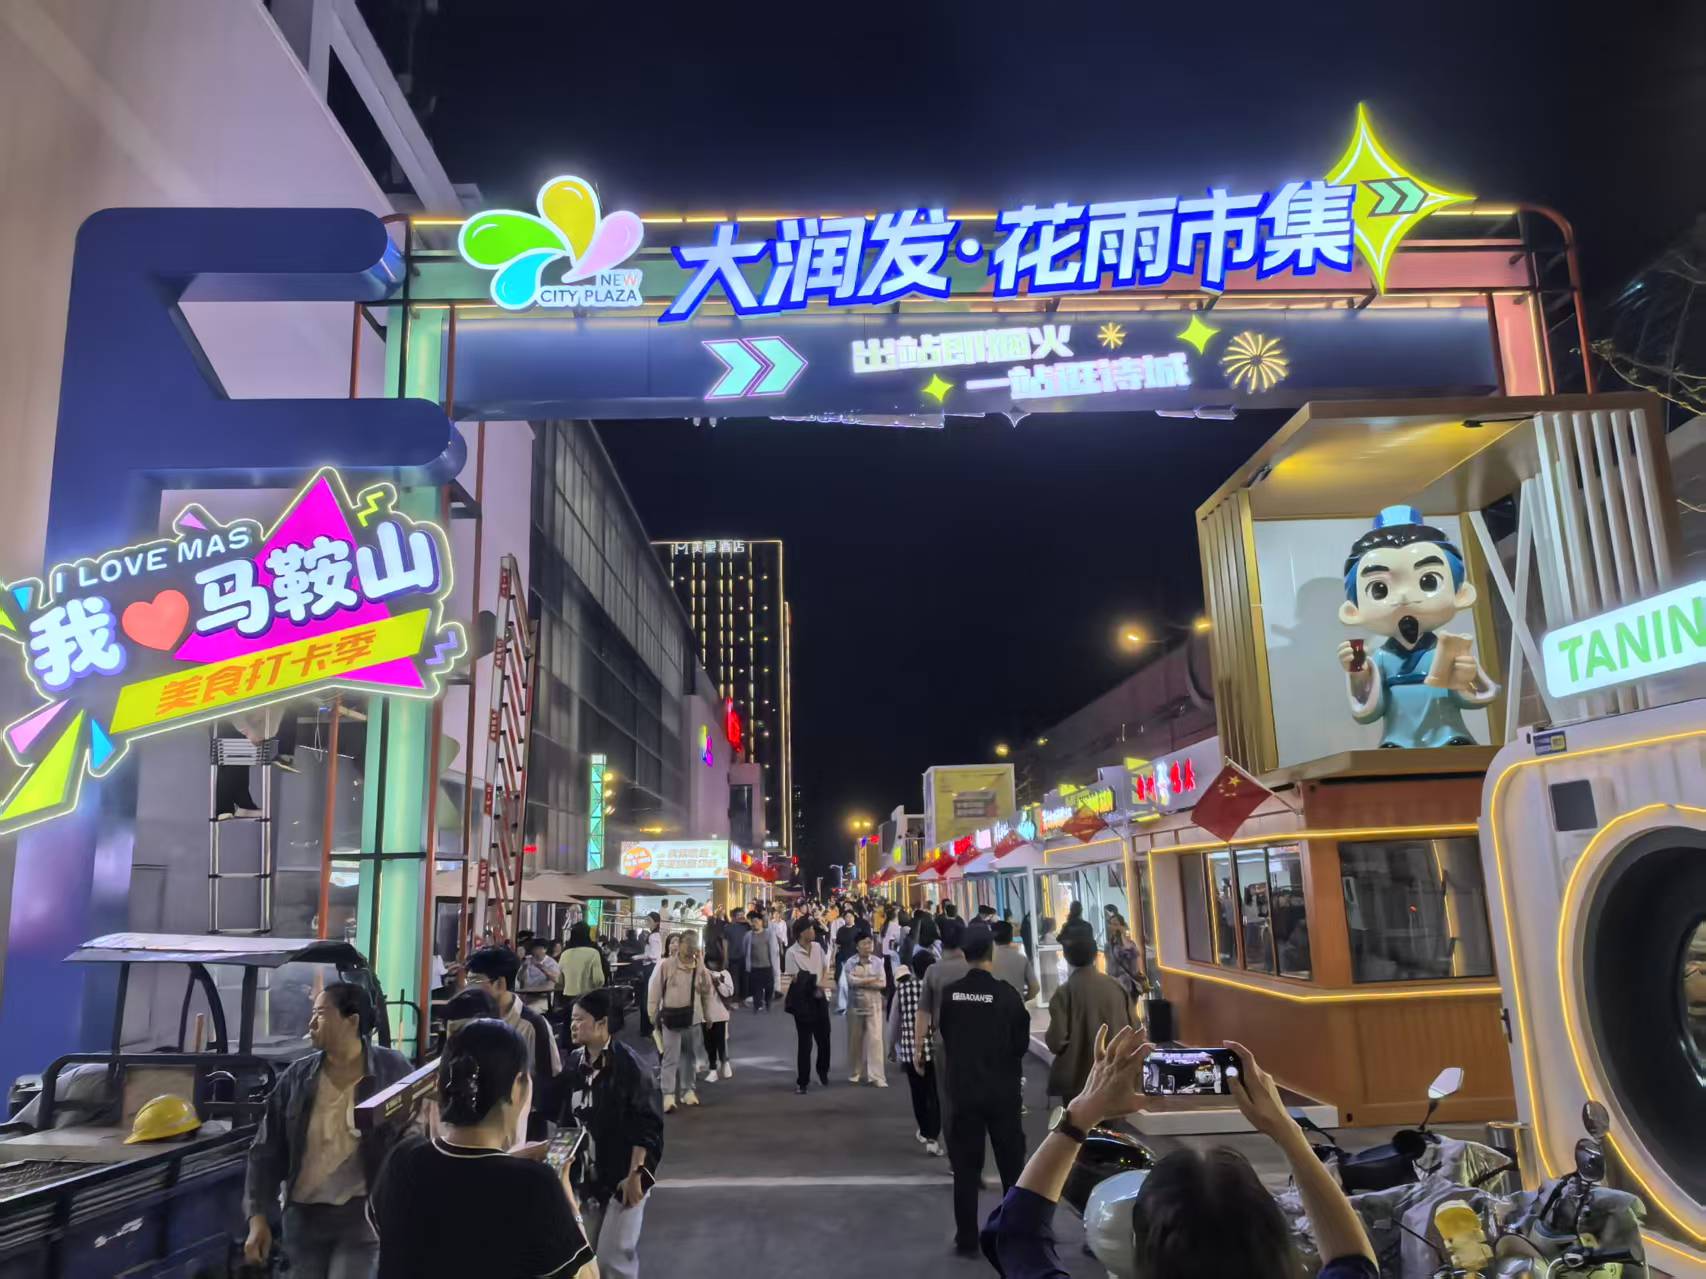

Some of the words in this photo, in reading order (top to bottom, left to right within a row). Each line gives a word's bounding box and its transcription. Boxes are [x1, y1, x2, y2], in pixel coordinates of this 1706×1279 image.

[600, 274, 637, 286] NEW
[660, 180, 1356, 321] 大润发·花雨市集
[540, 290, 578, 303] CITY
[584, 289, 637, 302] PLAZA
[56, 571, 65, 594] I
[78, 547, 168, 588] LOVE
[177, 526, 251, 564] MAS
[29, 595, 122, 687] 我
[195, 520, 439, 636] 马鞍山
[1557, 596, 1706, 682] TANIN
[156, 629, 377, 717] 美食打卡季
